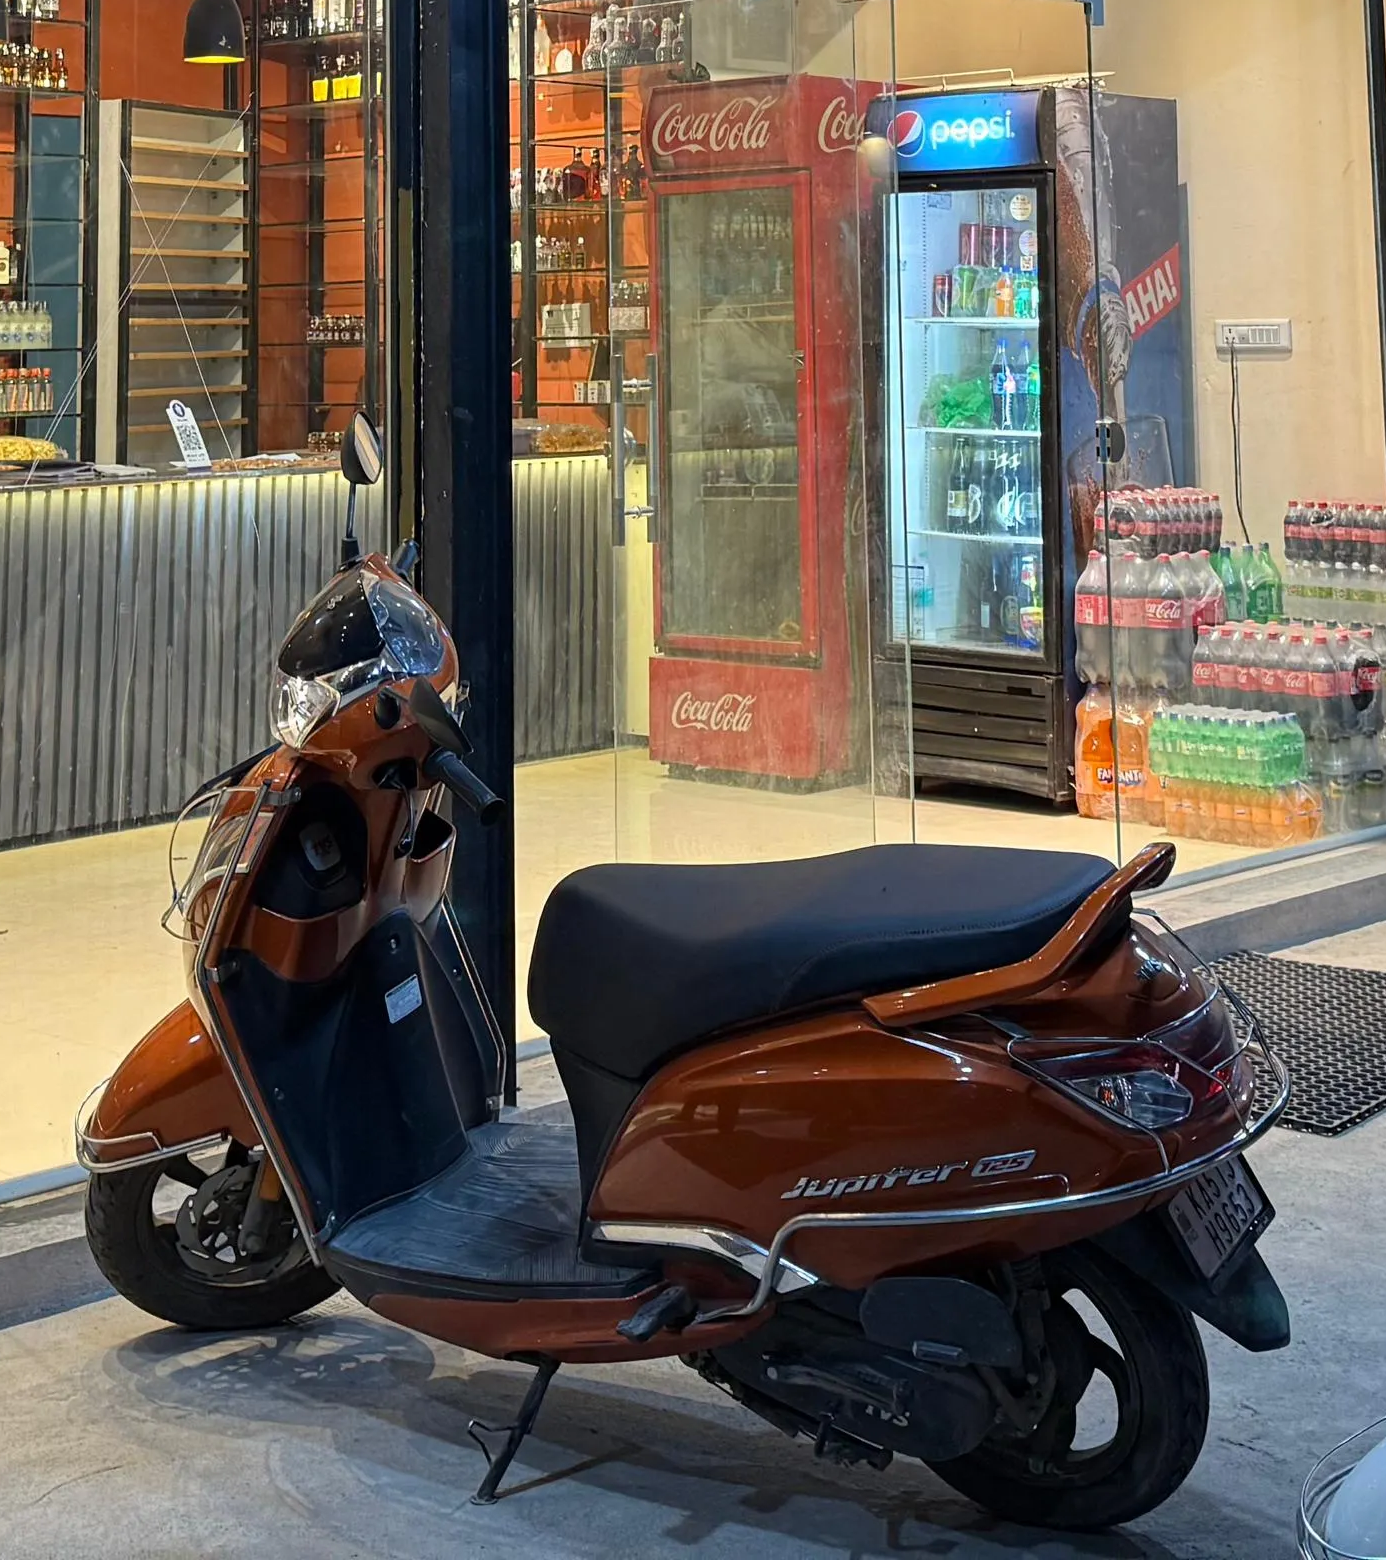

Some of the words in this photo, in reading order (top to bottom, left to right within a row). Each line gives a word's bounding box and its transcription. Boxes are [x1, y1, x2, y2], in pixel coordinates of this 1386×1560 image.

[652, 96, 778, 156] Coca-Cola
[930, 109, 1013, 151] pepsi
[1125, 260, 1178, 334] AHA!
[671, 691, 757, 732] Coca-Cola
[978, 1153, 1030, 1176] 125
